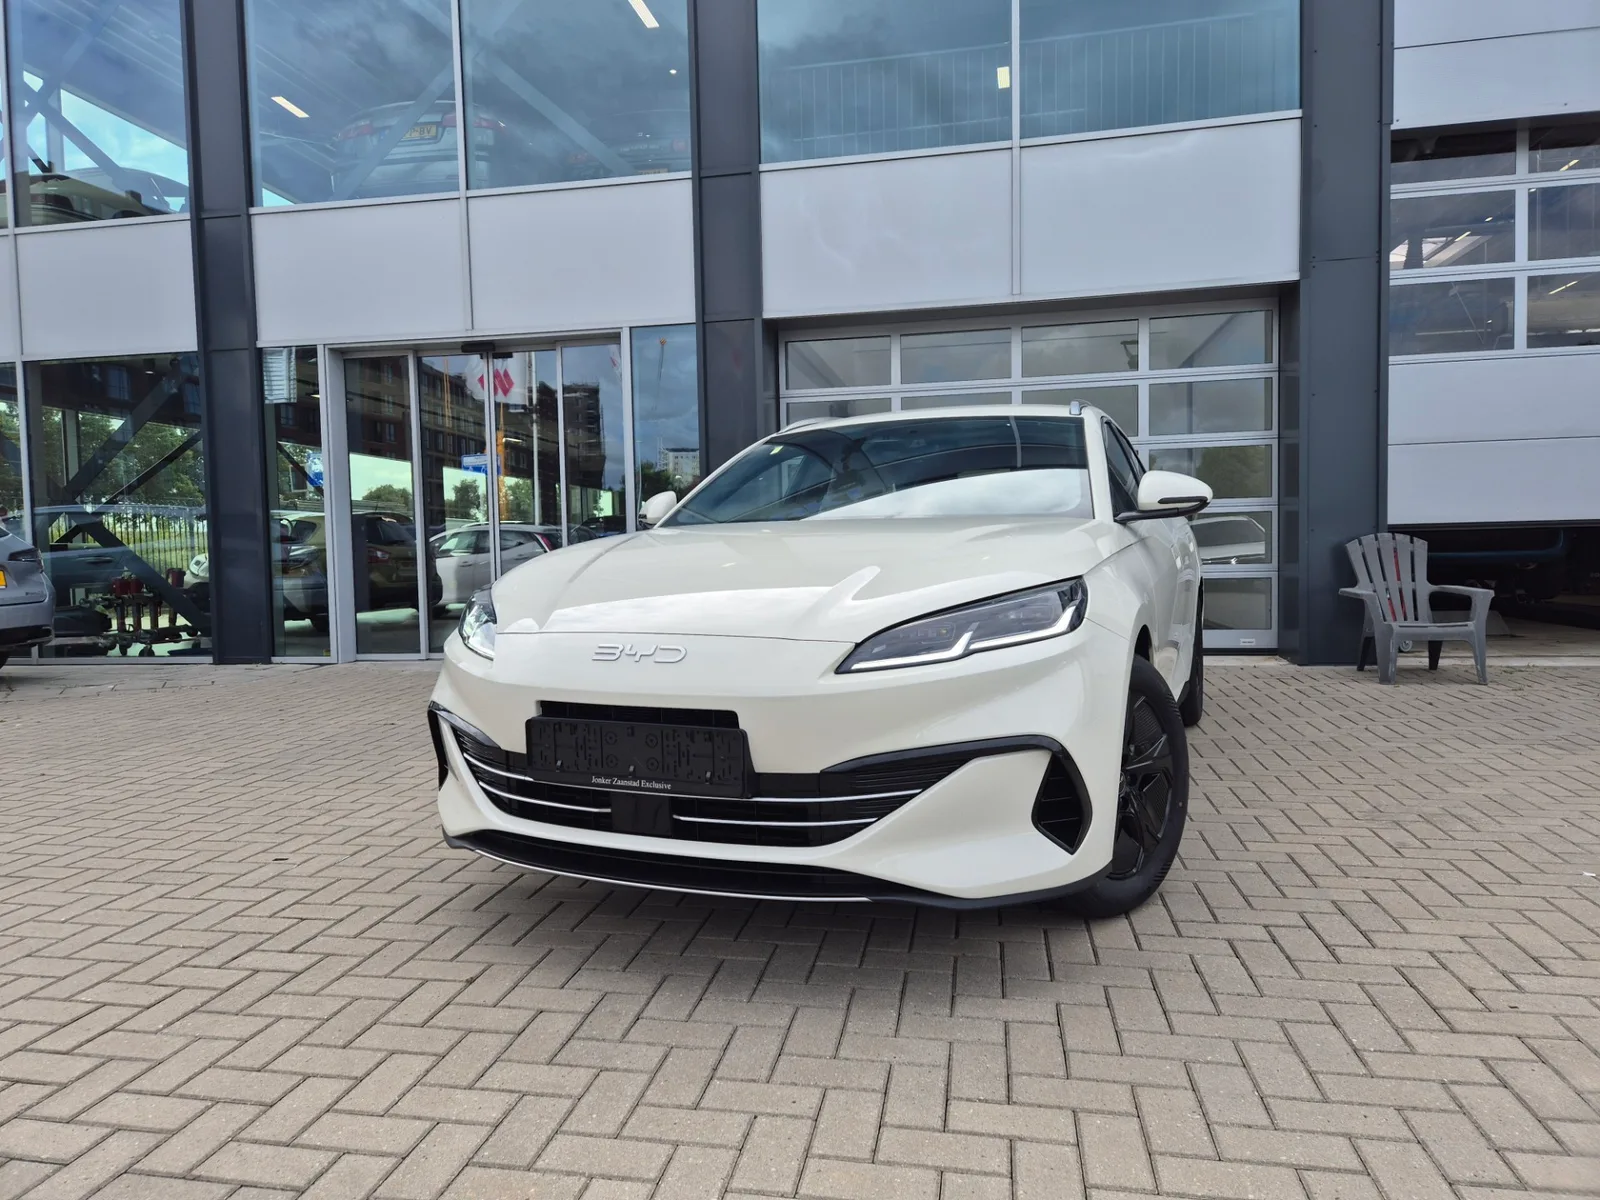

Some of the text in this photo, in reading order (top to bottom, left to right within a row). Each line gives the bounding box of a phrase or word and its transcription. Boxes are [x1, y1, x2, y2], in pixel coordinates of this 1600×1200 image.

[591, 643, 687, 664] BYD
[591, 775, 672, 790] Jonker Zaanstad Exclusive
